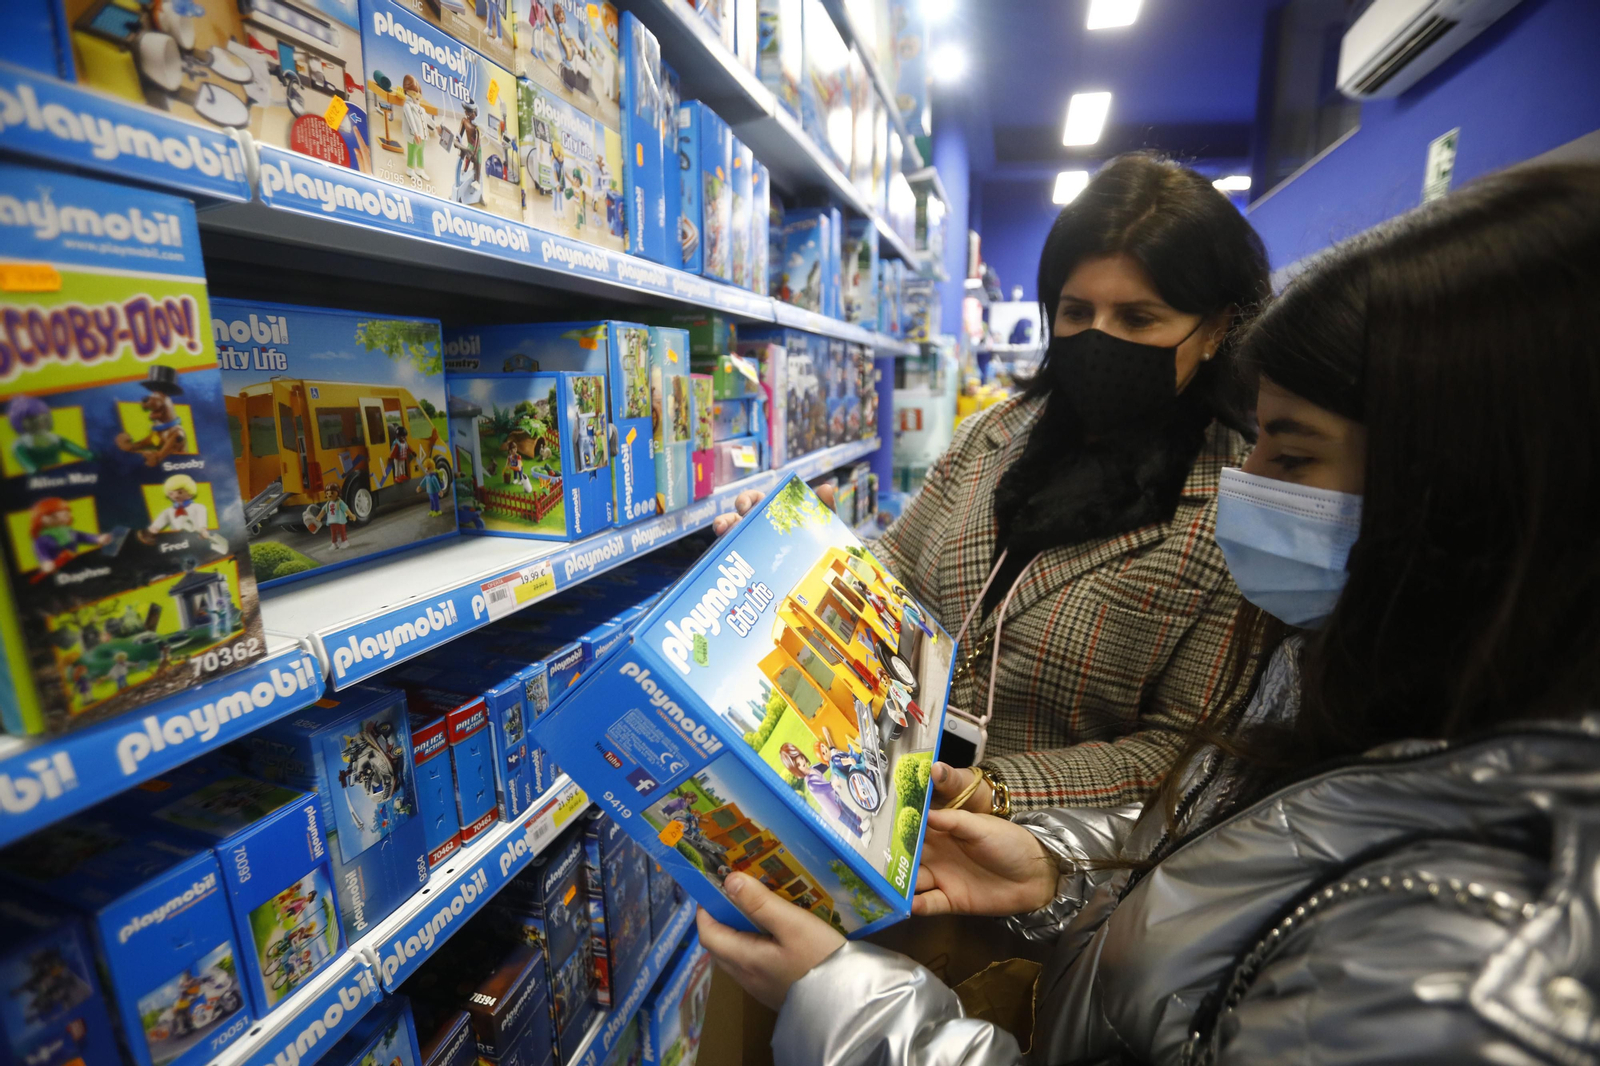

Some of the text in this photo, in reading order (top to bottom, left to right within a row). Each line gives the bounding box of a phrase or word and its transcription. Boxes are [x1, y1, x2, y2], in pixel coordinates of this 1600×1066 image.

[373, 12, 467, 75] playmobil
[421, 61, 448, 92] City
[449, 74, 471, 102] Life
[0, 84, 246, 183] playmobil
[534, 97, 593, 140] playmobil
[561, 130, 593, 160] City Life
[260, 160, 414, 224] playmobil
[379, 168, 405, 184] 70195
[410, 177, 423, 190] 39
[432, 207, 531, 253] playmobil
[541, 239, 610, 273] playmobil
[252, 346, 288, 370] Life
[162, 458, 205, 472] Scooby
[620, 443, 634, 520] playmobil
[664, 446, 674, 507] playmobil
[571, 487, 582, 534] playmobil
[160, 540, 190, 552] Fred
[631, 513, 676, 552] playmobil
[564, 534, 625, 581] playmobil
[487, 577, 504, 588] OFERTA
[662, 550, 756, 675] playmobil
[725, 581, 775, 638] City Life
[190, 637, 260, 678] 70362
[333, 599, 459, 679] playmobil
[550, 648, 583, 676] playmobil
[115, 657, 317, 776] playmobil
[454, 710, 484, 733] POLICE
[465, 716, 486, 733] ACTION
[618, 661, 724, 755] playmobil
[413, 731, 445, 755] POLICE
[424, 737, 447, 756] ACTION
[531, 749, 543, 794] playmobil
[508, 778, 519, 815] playmobil
[602, 790, 633, 819] 9419
[304, 804, 324, 859] playmobil
[473, 814, 493, 834] 70462
[233, 845, 252, 884] 70093
[419, 854, 428, 883] 9364
[432, 841, 455, 861] 70462
[546, 841, 581, 894] playmobil
[895, 855, 909, 889] 9419
[118, 872, 217, 944] playmobil
[344, 872, 368, 932] playmobil
[380, 867, 489, 986] playmobil
[264, 969, 376, 1066] ymobil
[469, 992, 497, 1007] 70394
[501, 977, 536, 1032] playmobil
[603, 966, 650, 1051] playmobil
[210, 1015, 250, 1051] 70051
